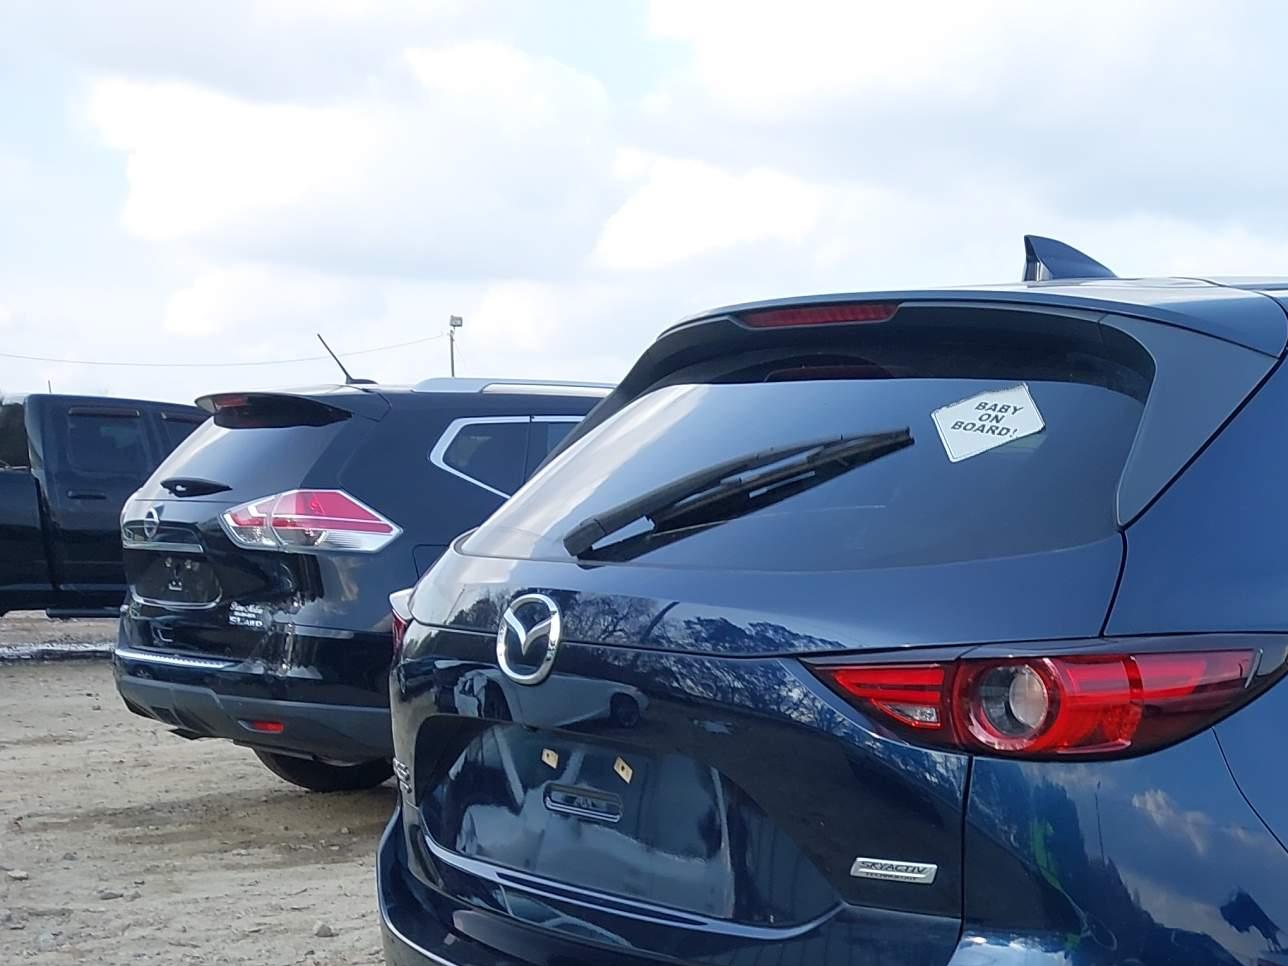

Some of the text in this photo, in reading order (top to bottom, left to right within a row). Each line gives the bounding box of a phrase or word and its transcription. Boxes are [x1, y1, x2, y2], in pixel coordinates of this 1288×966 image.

[974, 401, 1024, 416] BABY
[978, 412, 1006, 424] ON
[950, 420, 1018, 438] BOARD!
[859, 861, 928, 874] SKYACTIV
